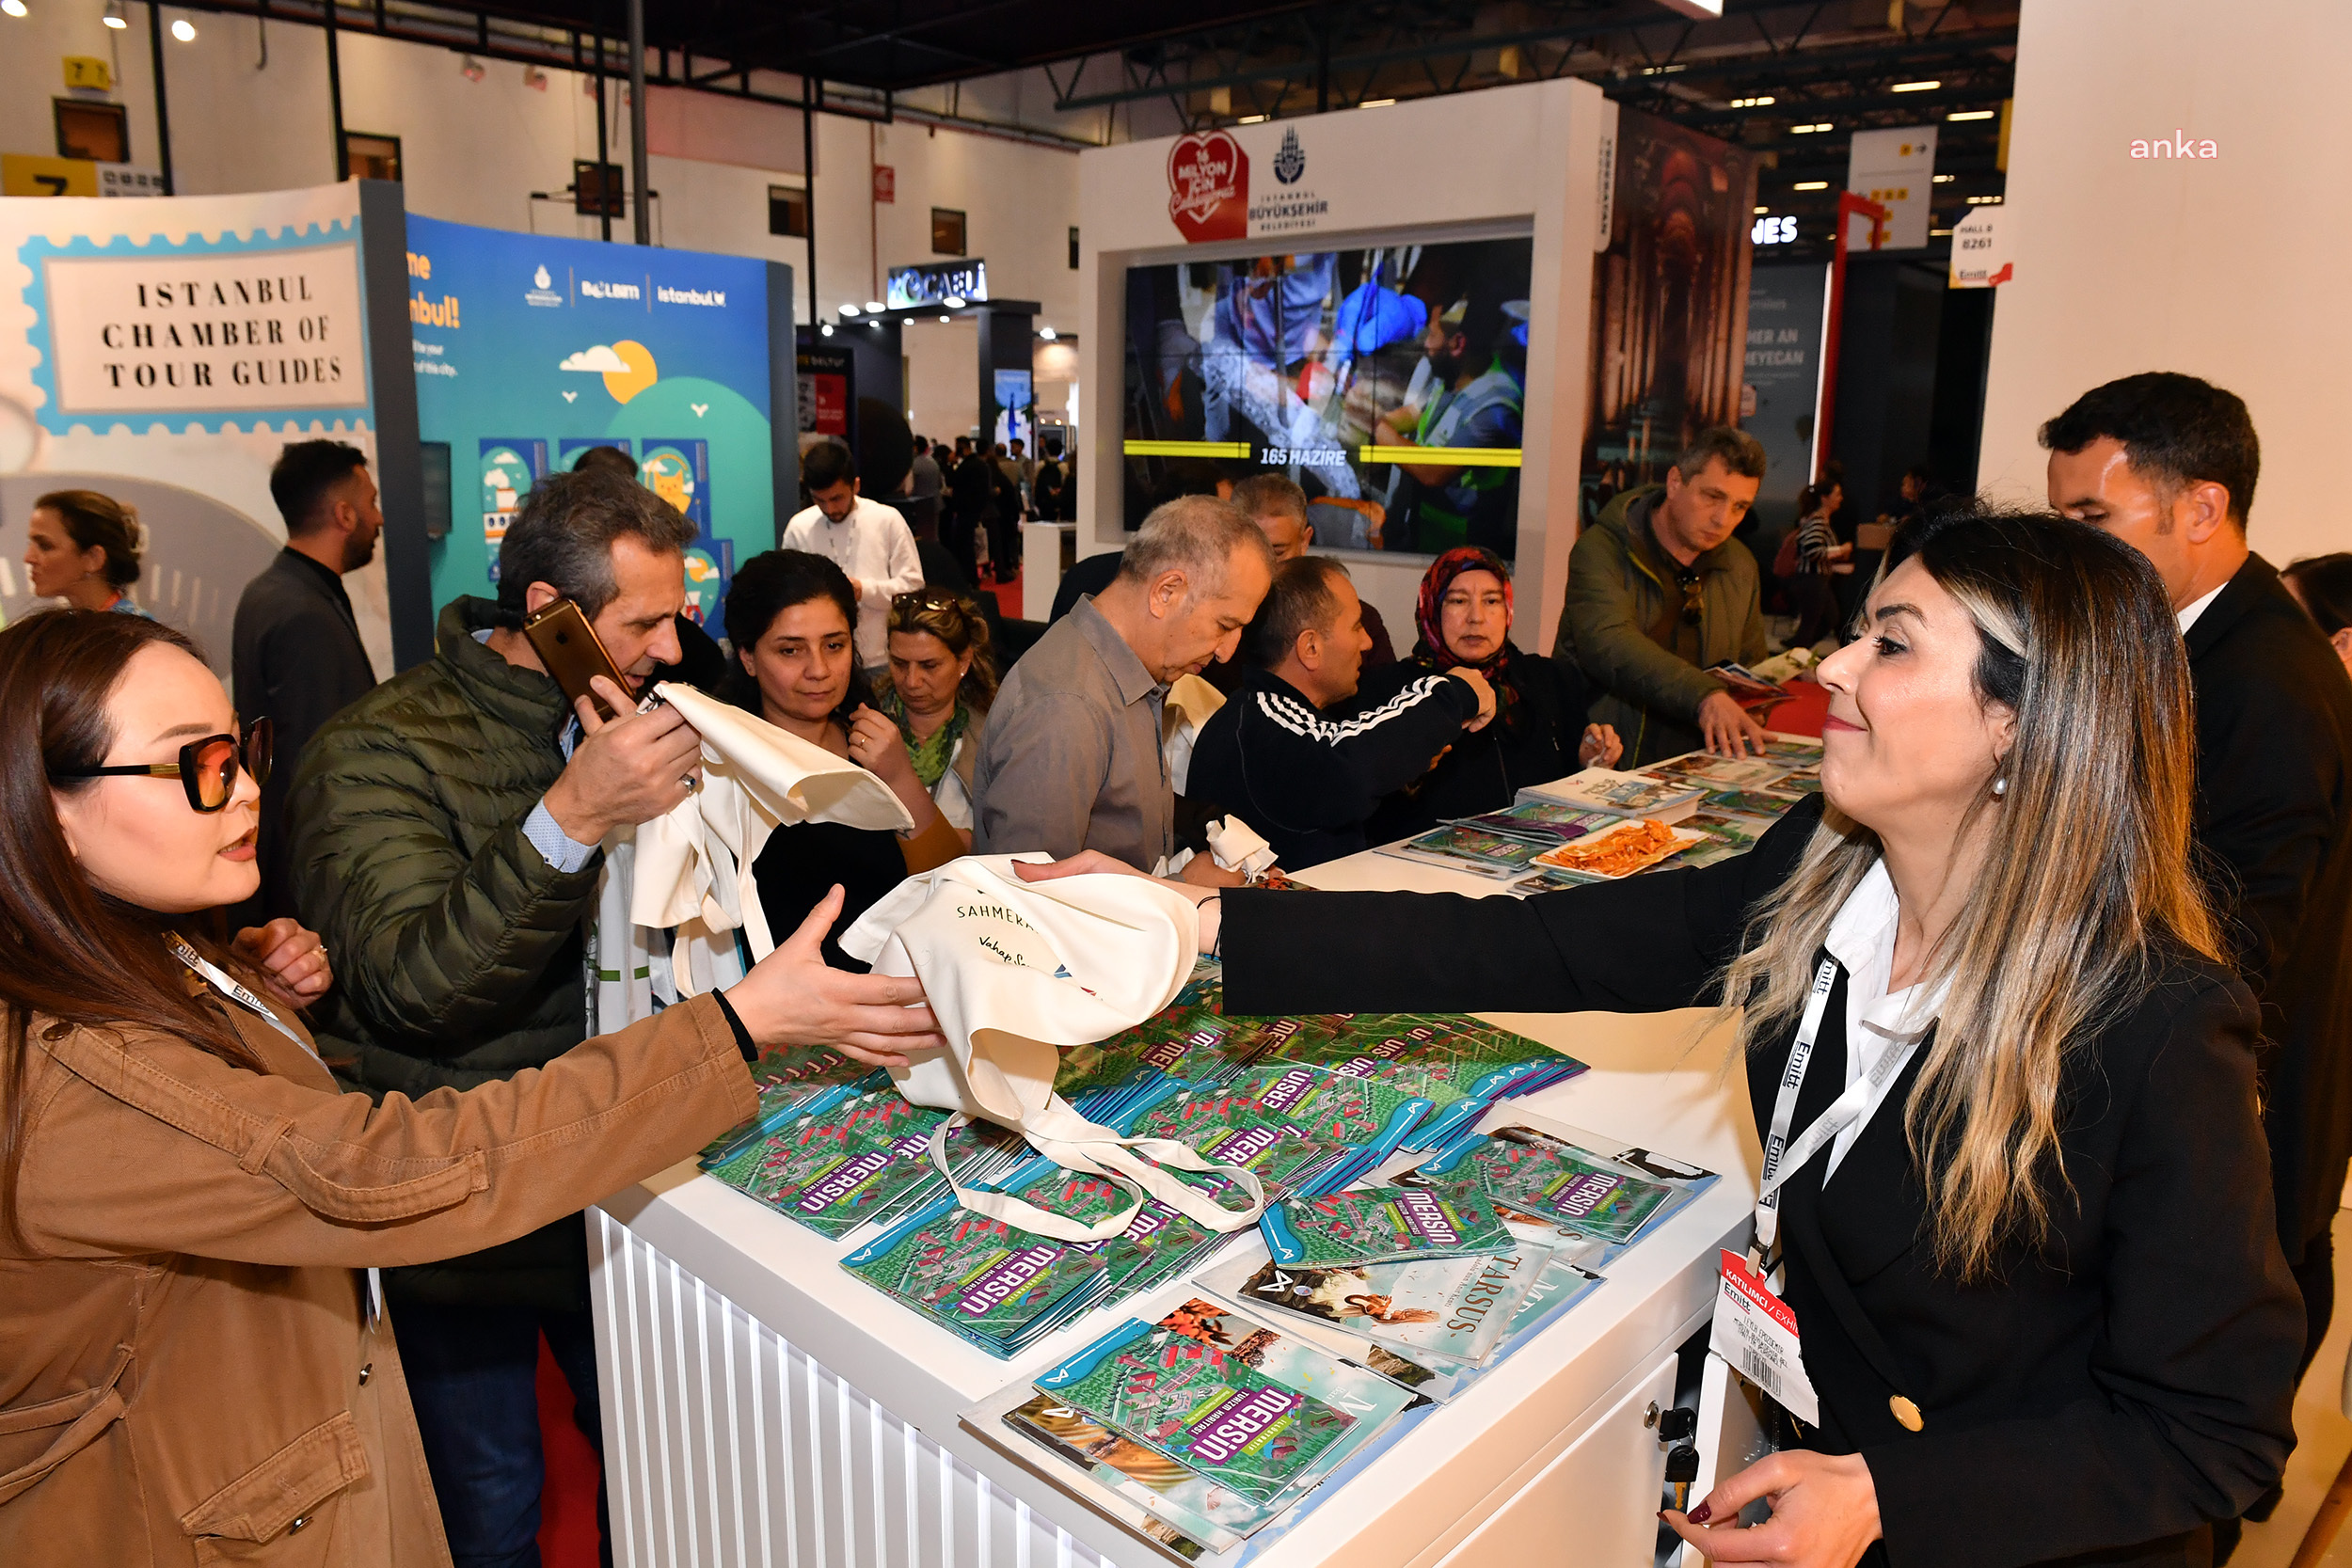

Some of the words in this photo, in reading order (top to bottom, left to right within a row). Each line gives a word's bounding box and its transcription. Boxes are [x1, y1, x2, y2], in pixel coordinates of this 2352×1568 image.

[136, 275, 313, 309] ISTANBUL
[102, 318, 284, 349] CHAMBER
[298, 316, 329, 342] OF
[103, 362, 214, 389] TOUR
[232, 356, 342, 387] GUIDES
[1261, 447, 1288, 465] 165
[1289, 445, 1347, 466] HAZİRE
[979, 936, 1012, 963] Vahap
[1787, 1041, 1810, 1090] Emitt
[1446, 1255, 1523, 1334] TARSUS
[1724, 1281, 1751, 1311] Emitt
[1725, 1269, 1768, 1308] KATILIMCI
[1222, 1391, 1249, 1411] TURİZM
